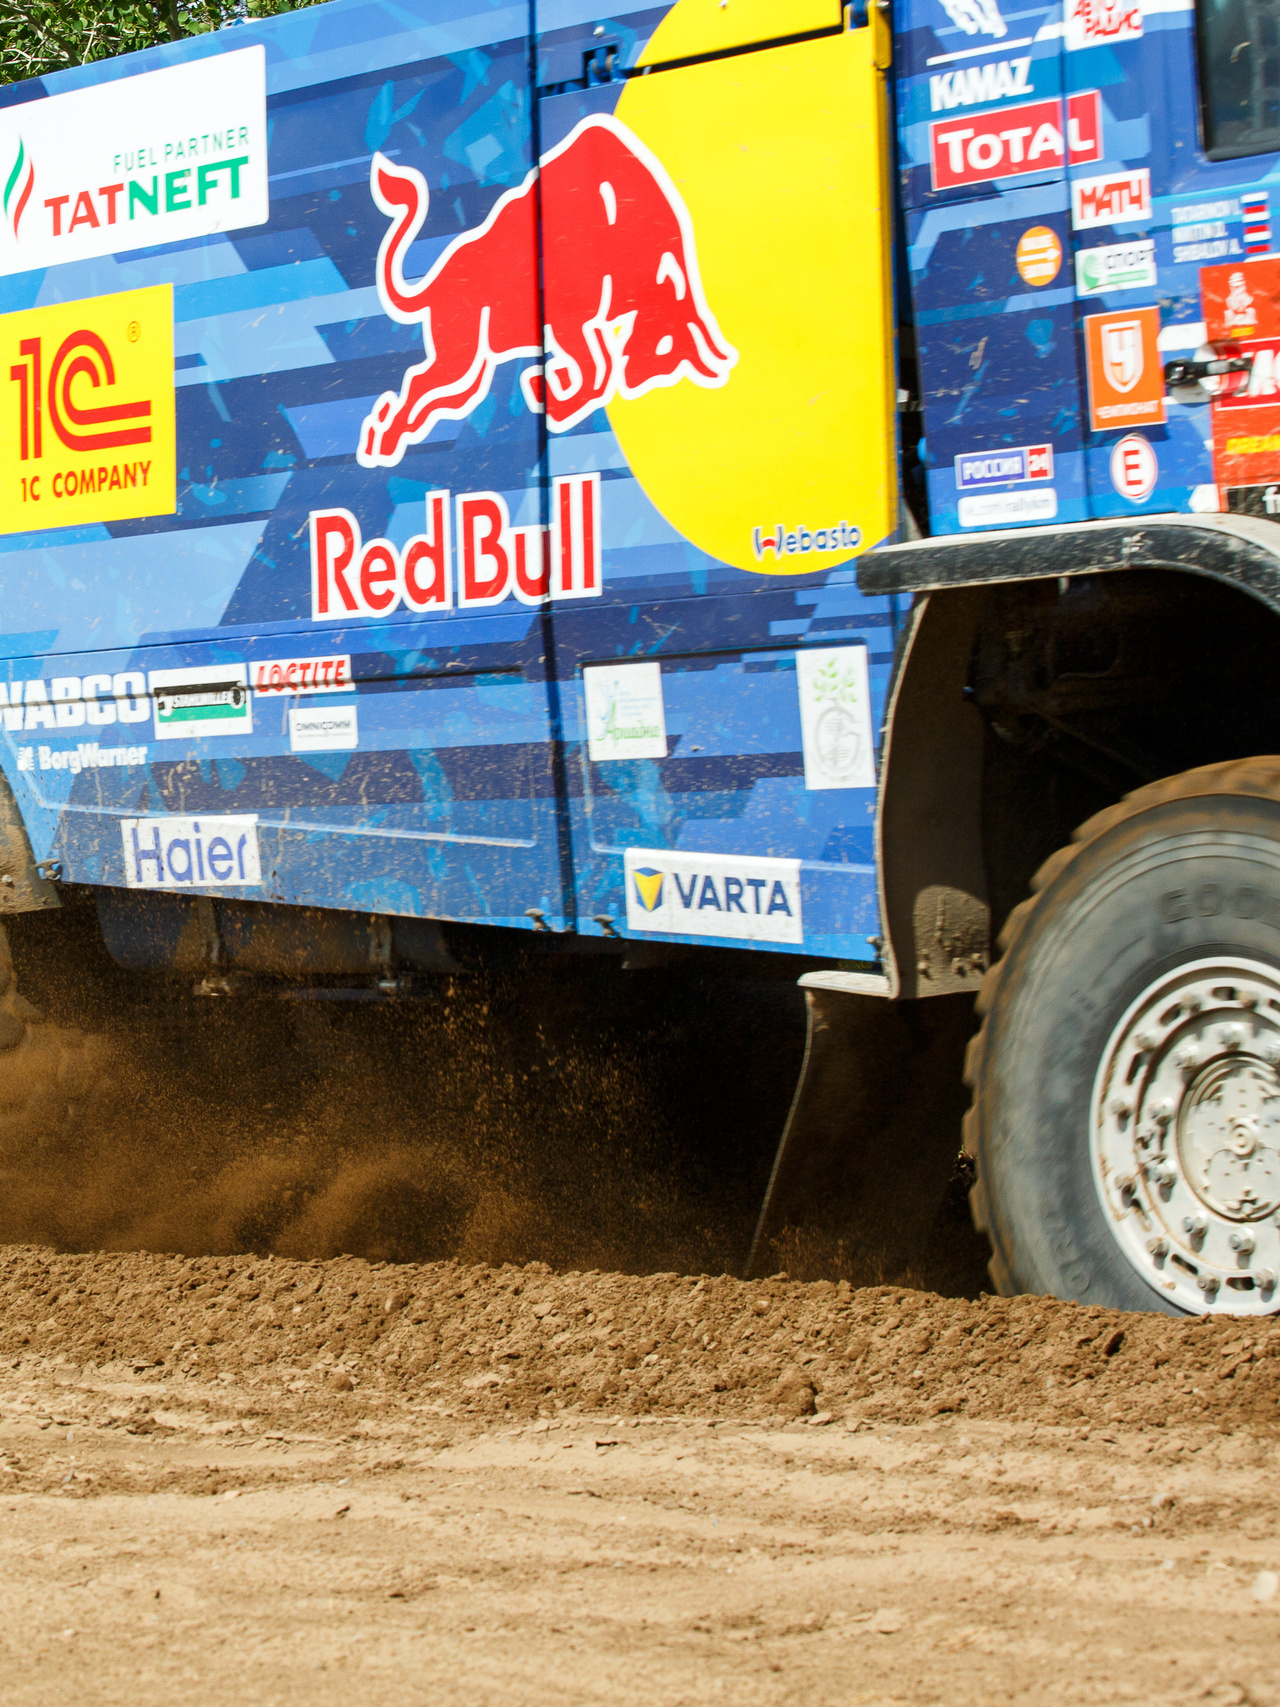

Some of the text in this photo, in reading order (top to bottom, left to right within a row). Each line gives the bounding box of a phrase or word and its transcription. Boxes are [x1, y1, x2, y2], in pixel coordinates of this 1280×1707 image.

[930, 56, 1034, 112] KAMAZ
[114, 127, 249, 174] FUEL PARTNER
[937, 118, 1095, 173] TOTAL
[44, 156, 249, 237] TATNEFT
[21, 460, 152, 502] 1C COMPANY
[1123, 450, 1143, 486] E
[754, 522, 861, 558] Webasto
[257, 660, 346, 693] LOCTITE
[39, 742, 148, 774] BorgWarner
[131, 822, 247, 882] Haier
[673, 872, 793, 918] VARTA
